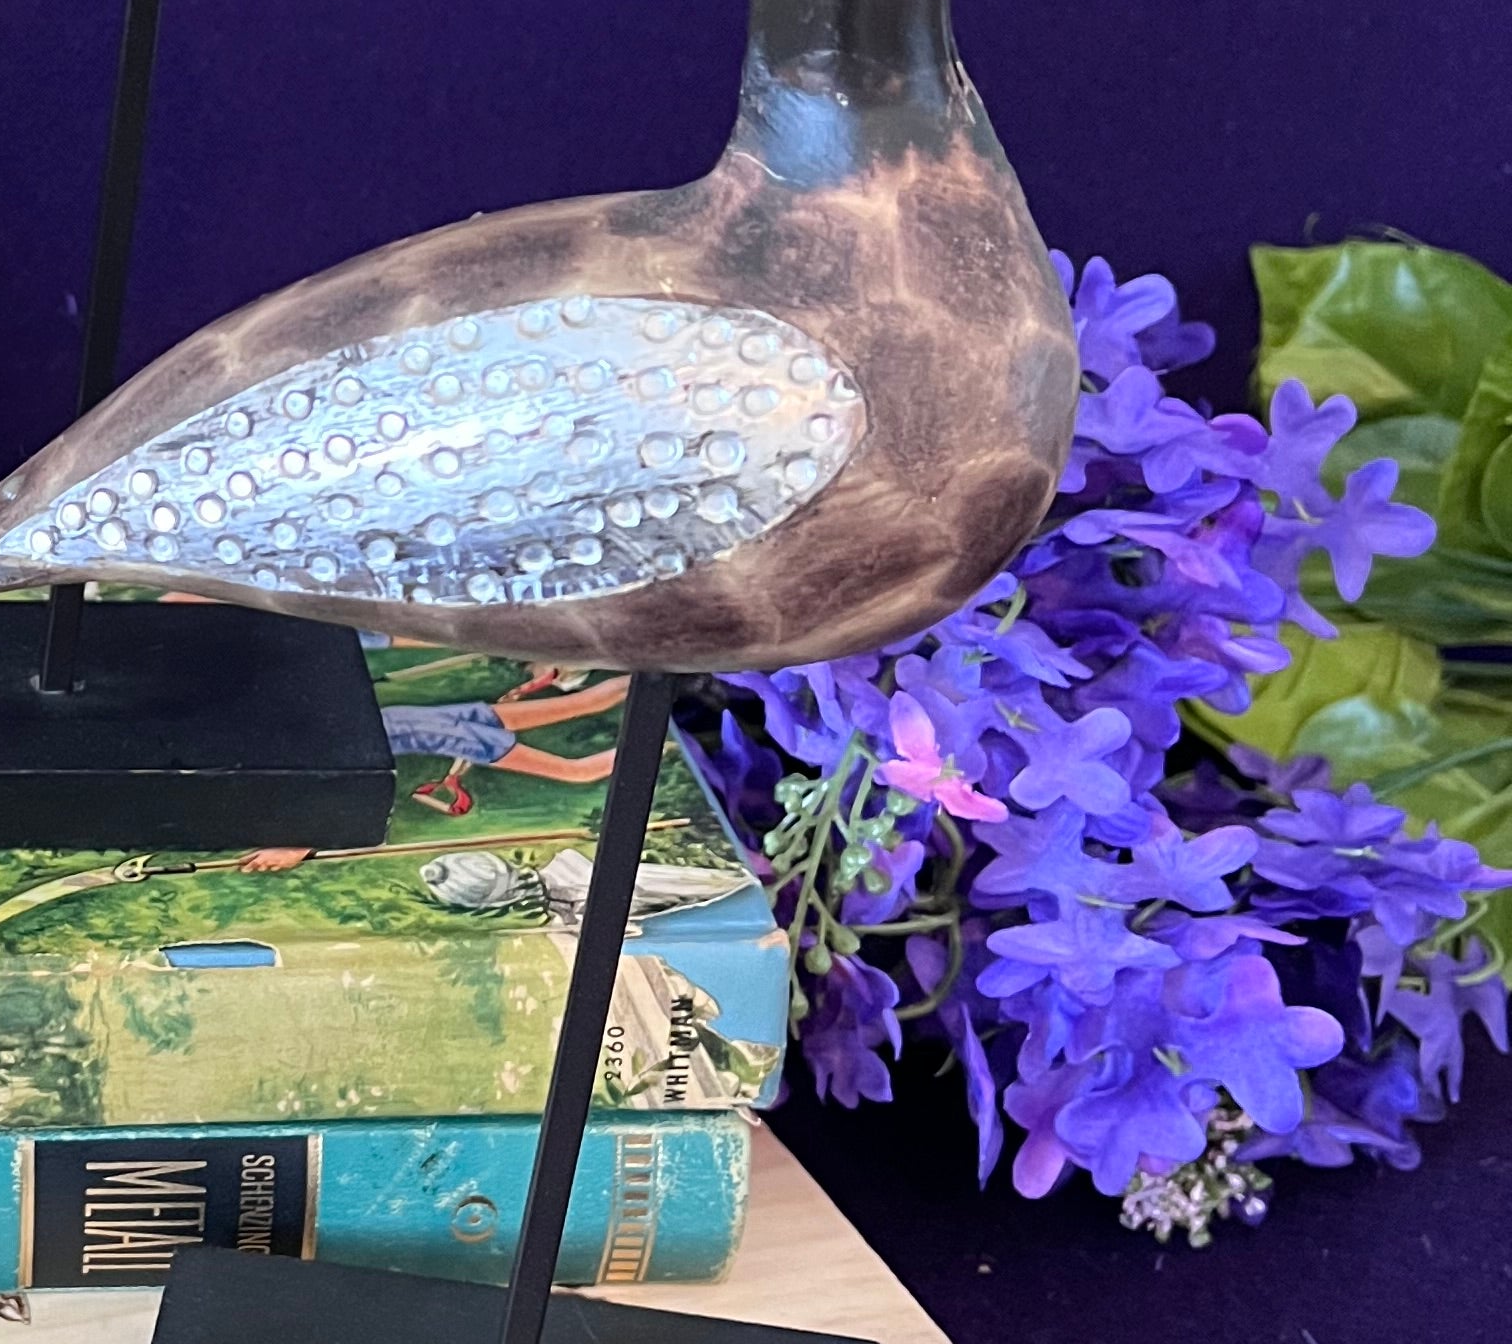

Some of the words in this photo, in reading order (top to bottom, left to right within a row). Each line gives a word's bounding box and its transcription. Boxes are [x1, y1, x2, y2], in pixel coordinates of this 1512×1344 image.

[604, 1026, 625, 1081] 2360
[664, 994, 694, 1104] WHITMAN
[83, 1160, 207, 1274] METALL
